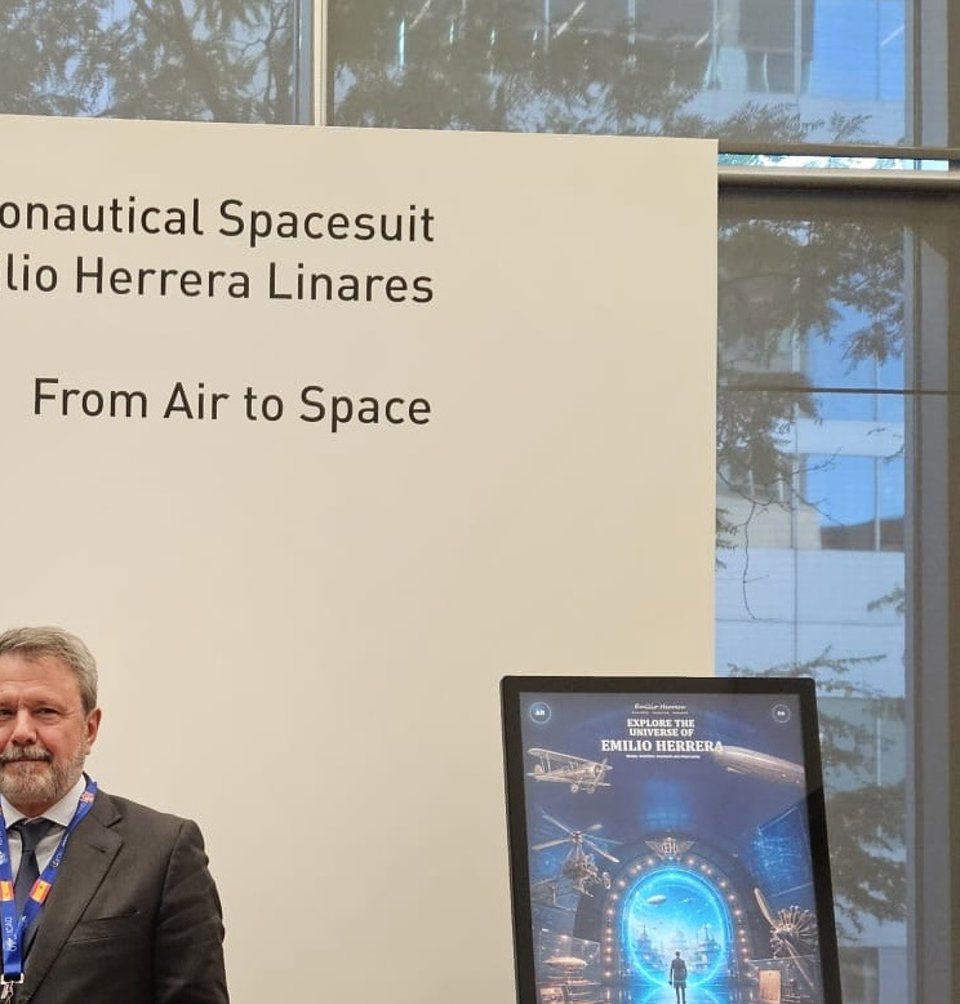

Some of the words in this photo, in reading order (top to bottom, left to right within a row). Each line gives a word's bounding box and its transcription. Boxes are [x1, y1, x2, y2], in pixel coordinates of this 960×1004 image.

[219, 199, 435, 248] Spacesuit
[76, 256, 250, 299] Herrera
[269, 262, 433, 303] Linares
[34, 377, 147, 418] From
[163, 381, 230, 420] Air
[243, 386, 284, 422] to
[300, 385, 431, 433] Space
[627, 719, 672, 728] EXPLORE
[675, 719, 695, 728] THE
[629, 728, 678, 737] UNIVERSE
[680, 728, 695, 737] OF
[601, 740, 653, 752] EMILIO
[655, 740, 724, 752] HERRERA
